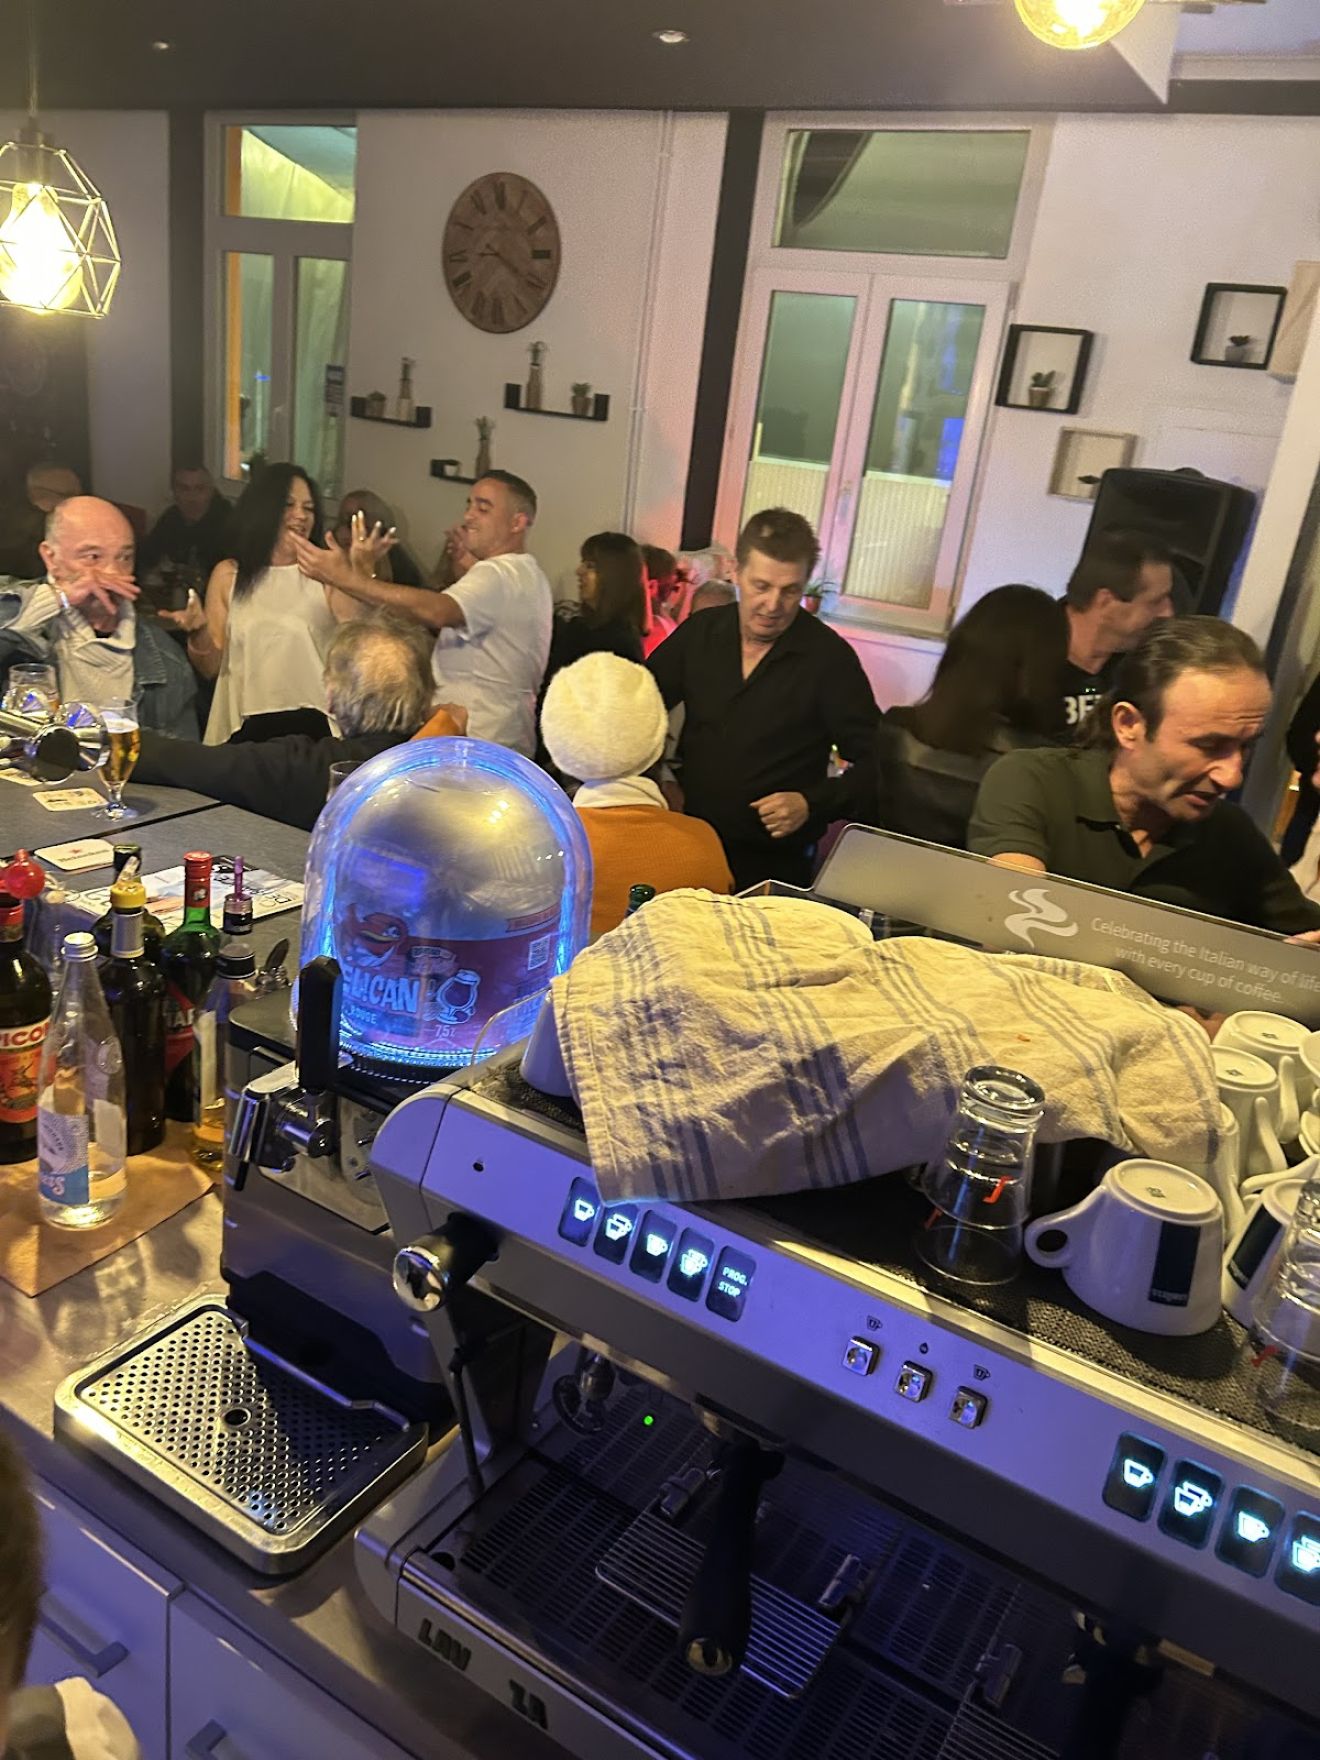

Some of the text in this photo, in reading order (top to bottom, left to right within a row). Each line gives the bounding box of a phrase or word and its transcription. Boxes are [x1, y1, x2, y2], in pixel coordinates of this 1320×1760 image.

[1091, 916, 1172, 954] Celebrating
[1173, 939, 1197, 958] the
[1199, 945, 1245, 971] Italian
[1247, 962, 1280, 983] way
[1280, 970, 1300, 986] of
[1115, 946, 1146, 965] with
[1148, 956, 1188, 980] every
[1187, 966, 1216, 988] cup
[1217, 975, 1236, 990] of
[718, 1281, 741, 1298] STOP
[722, 1266, 748, 1286] PROG.
[418, 1618, 472, 1672] LAV
